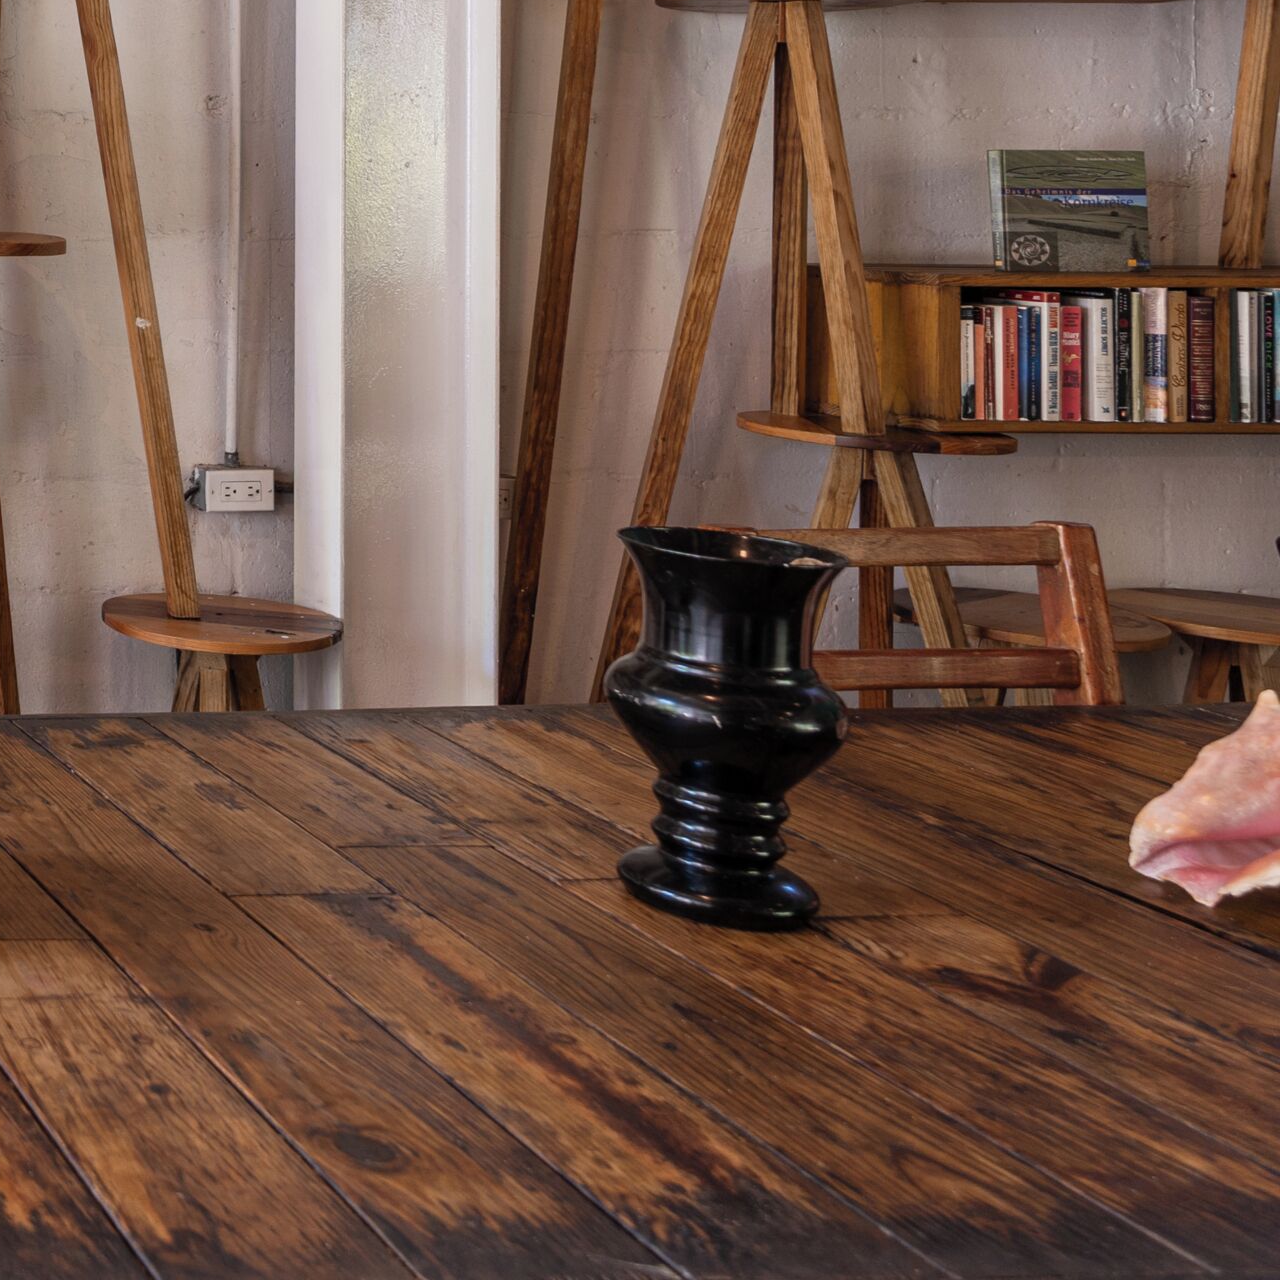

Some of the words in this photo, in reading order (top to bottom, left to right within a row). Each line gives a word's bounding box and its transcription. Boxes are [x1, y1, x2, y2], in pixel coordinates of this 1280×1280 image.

[1063, 196, 1133, 208] Kornkreise
[1100, 307, 1108, 335] SELECTOS
[1048, 347, 1057, 367] Thomas
